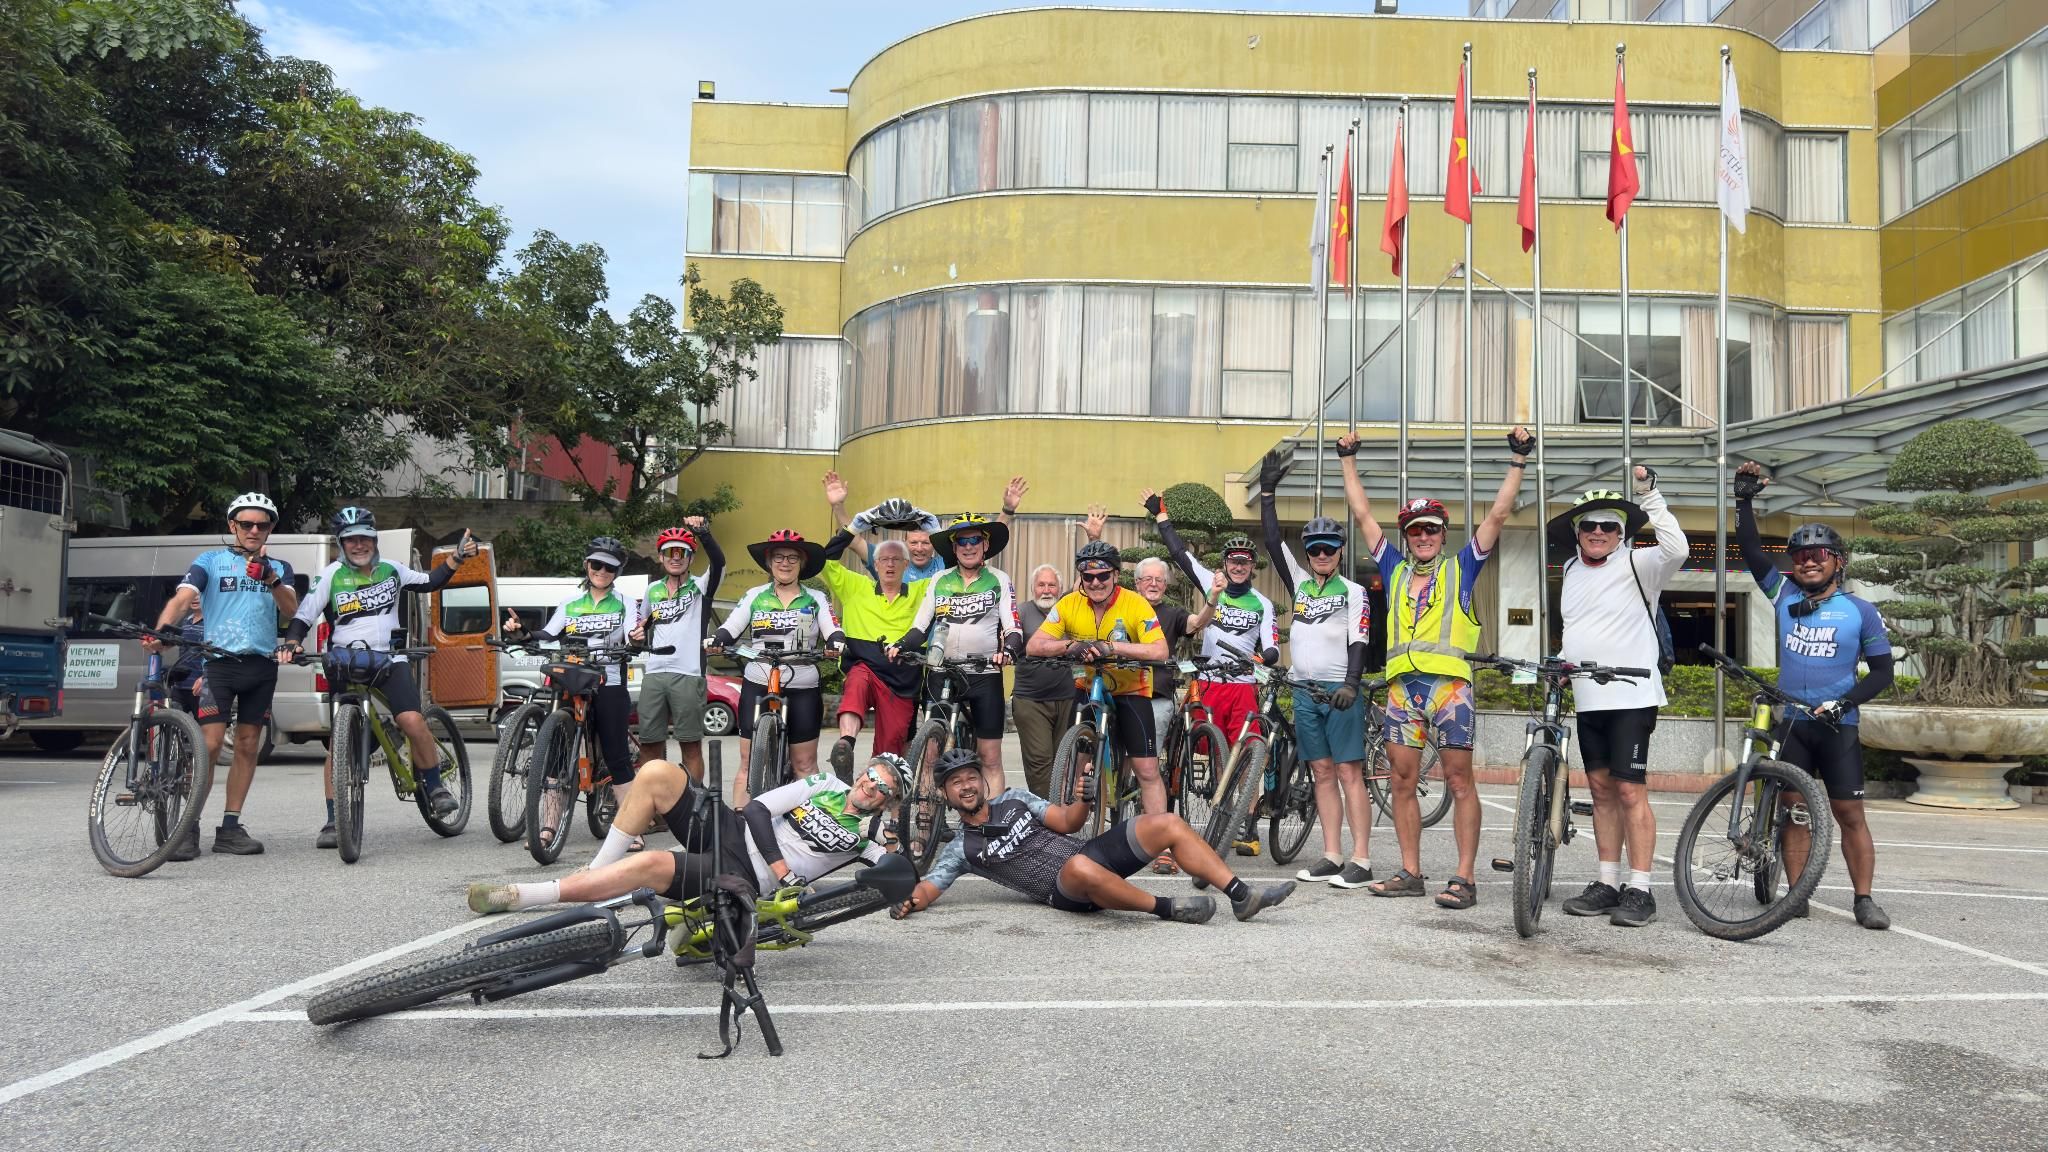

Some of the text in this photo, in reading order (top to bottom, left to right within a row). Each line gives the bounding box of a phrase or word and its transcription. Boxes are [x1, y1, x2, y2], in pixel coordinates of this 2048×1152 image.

[337, 578, 396, 605] BANGERS
[935, 590, 993, 607] BANGERS
[367, 592, 393, 607] NOI
[955, 601, 984, 615] NOI
[581, 620, 611, 631] NOI
[1222, 616, 1248, 627] NOI
[1793, 623, 1836, 642] CRANK
[70, 647, 105, 656] VIETNAM
[1785, 633, 1838, 658] POTTERS
[69, 659, 117, 667] ADVENTURE
[67, 670, 102, 678] CYCLING
[93, 781, 103, 800] JACK
[99, 752, 114, 780] RABBIT
[805, 820, 841, 846] NOI
